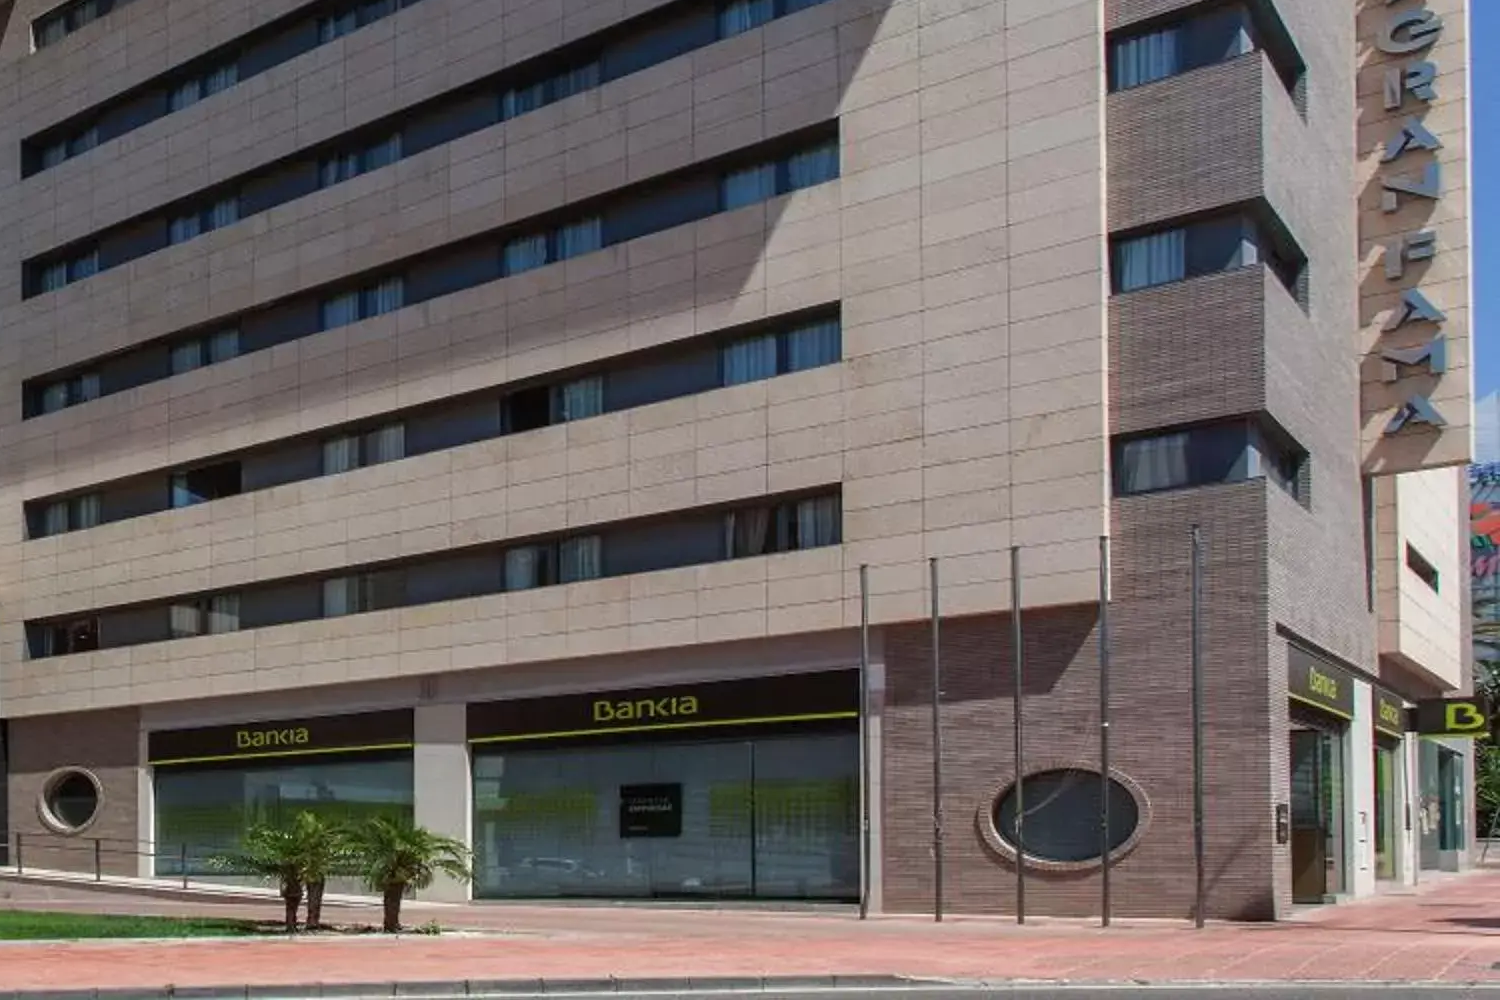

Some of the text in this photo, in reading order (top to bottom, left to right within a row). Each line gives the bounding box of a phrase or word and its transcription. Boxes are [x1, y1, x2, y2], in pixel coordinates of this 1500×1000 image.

[1374, 7, 1445, 215] GRAN
[1381, 228, 1448, 437] FAMA
[236, 726, 309, 749] Bankia
[594, 695, 699, 723] Bankia
